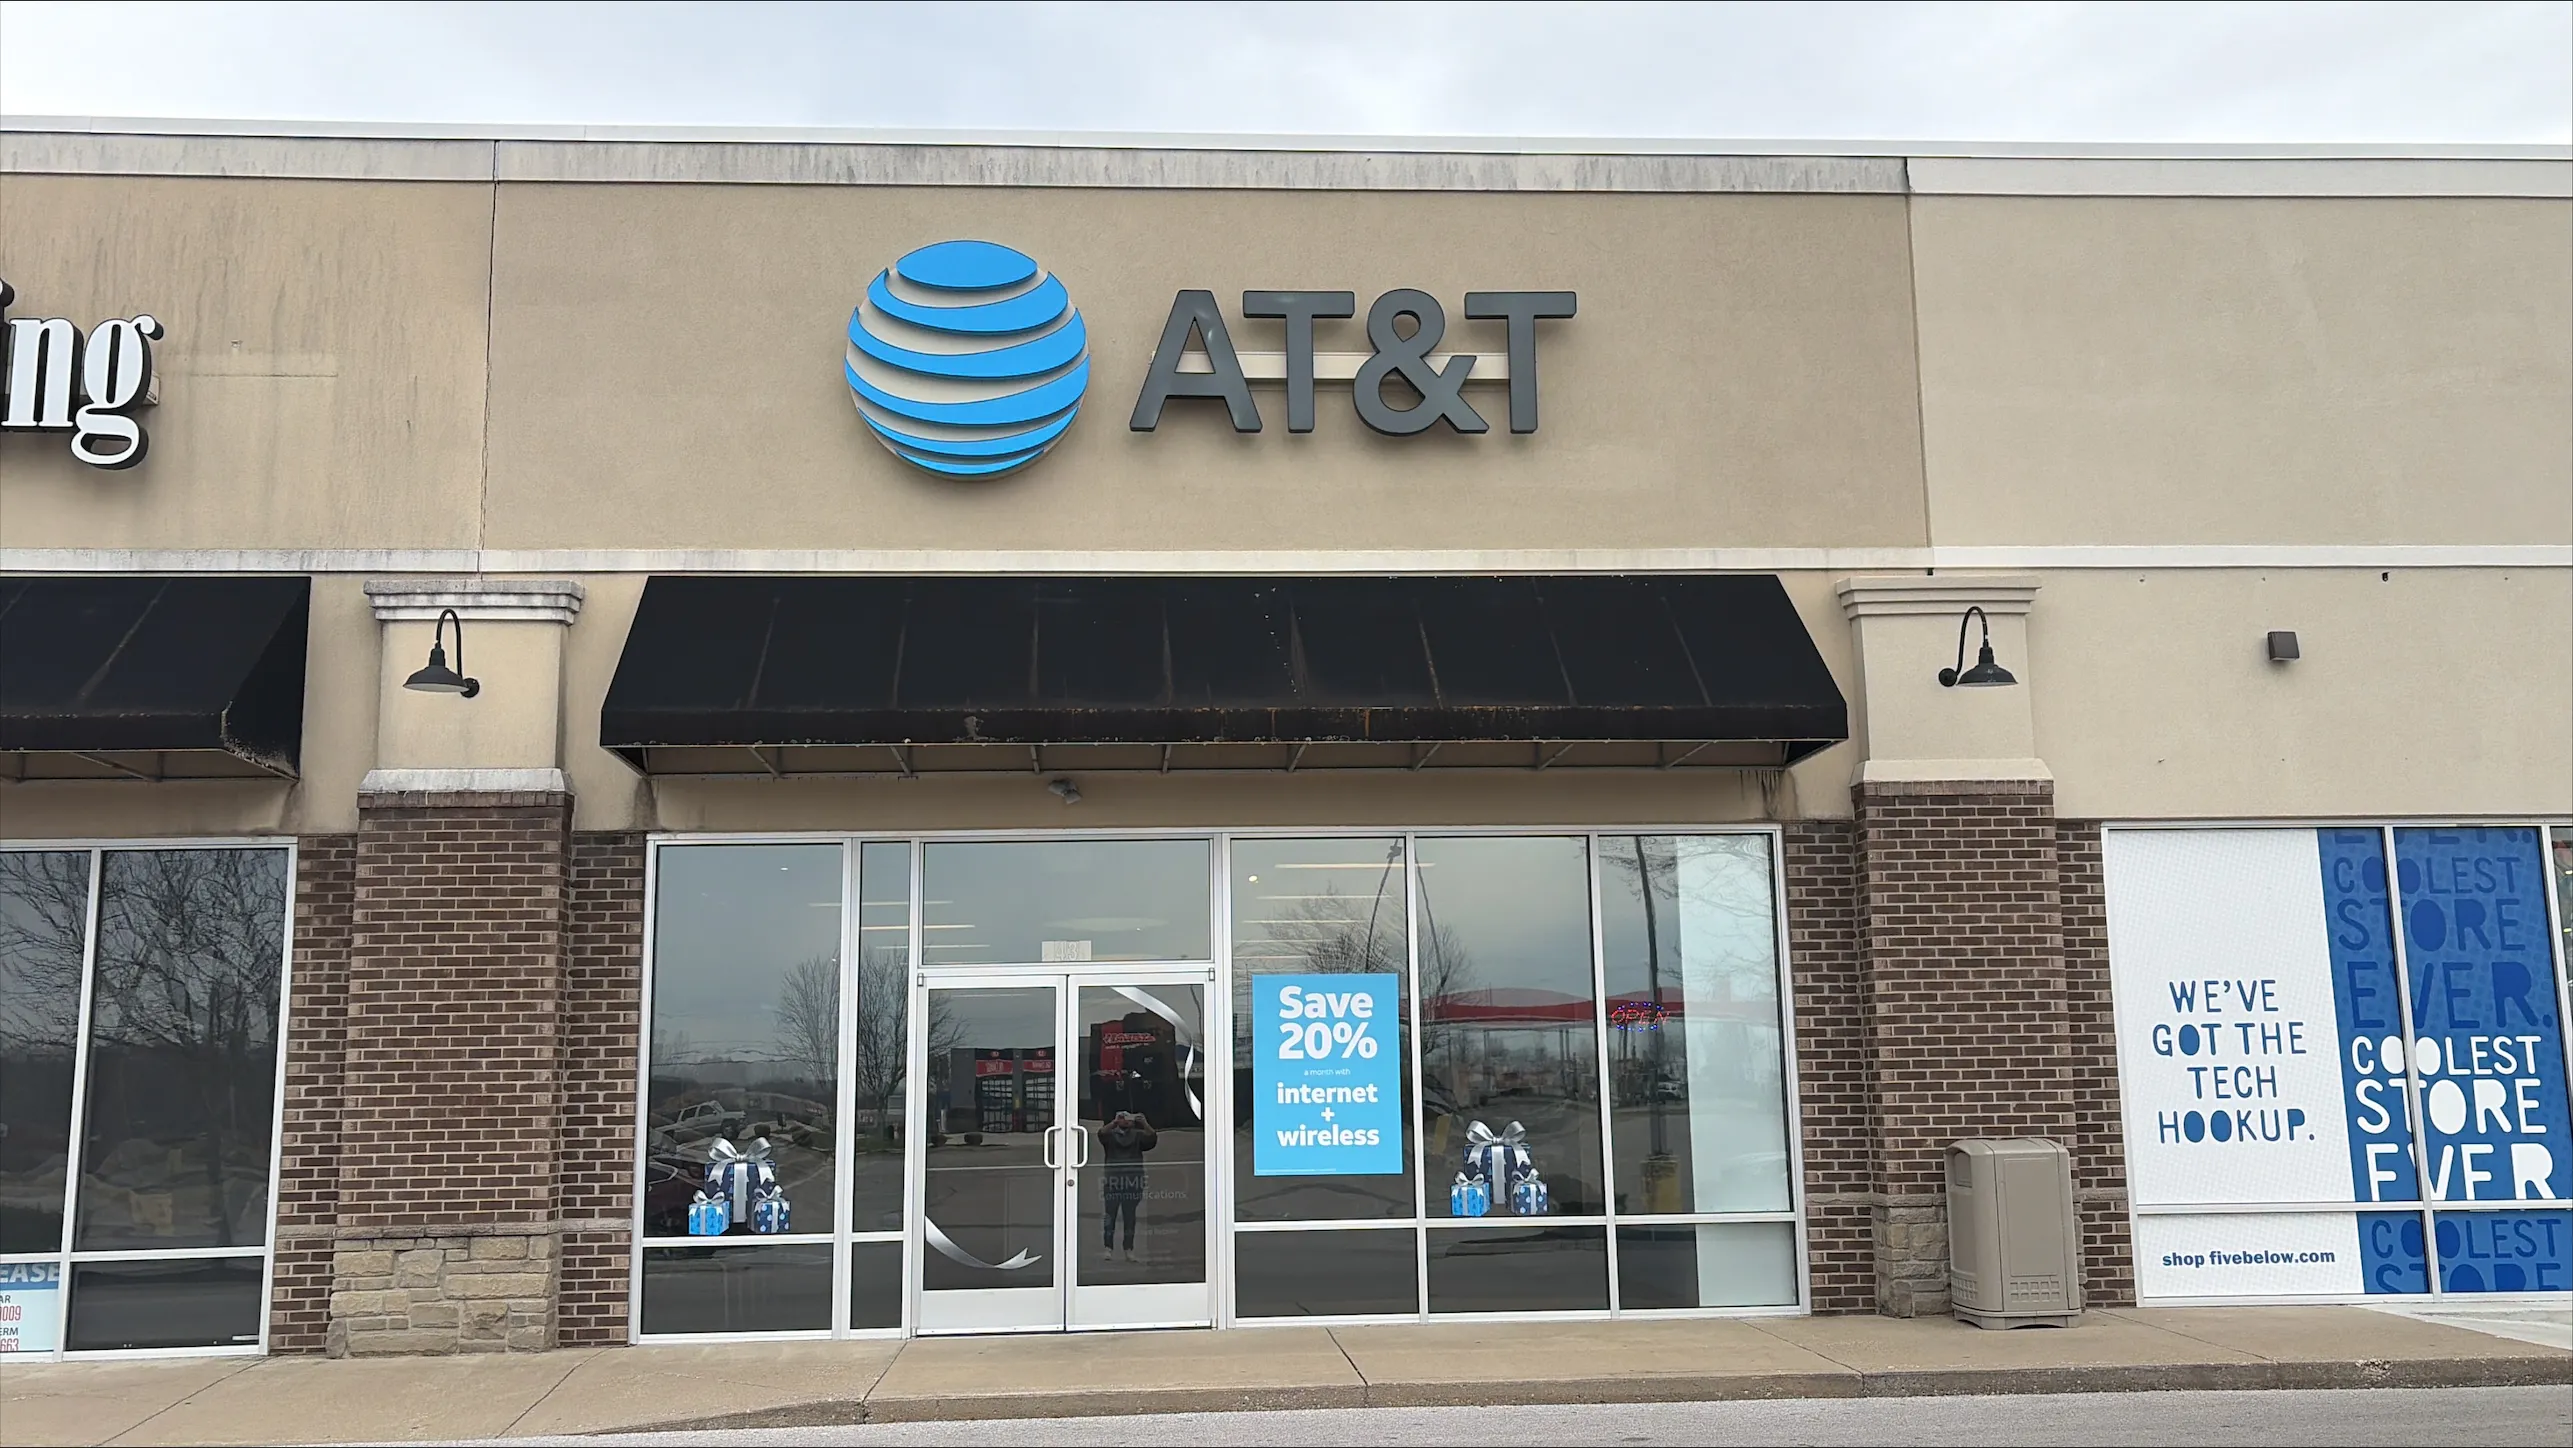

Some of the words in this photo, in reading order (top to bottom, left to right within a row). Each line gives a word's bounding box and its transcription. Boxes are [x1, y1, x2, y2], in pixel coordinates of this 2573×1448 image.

[1129, 288, 1577, 437] AT&T
[2333, 856, 2521, 895] COOLEST
[2337, 898, 2526, 952] STORE
[1279, 985, 1374, 1019] Save
[2169, 979, 2279, 1013] WE'VE
[2347, 961, 2554, 1029] EVER.
[1611, 1009, 1671, 1025] OPEN
[1279, 1022, 1378, 1060] 20%
[2152, 1023, 2222, 1057] GOT
[2234, 1021, 2307, 1055] THE
[2352, 1035, 2542, 1075] COOLEST
[1310, 1068, 1334, 1076] month
[1334, 1068, 1351, 1076] with
[2187, 1065, 2278, 1099] TECH
[1277, 1082, 1379, 1104] internet
[2355, 1078, 2547, 1135] STORE
[1277, 1124, 1380, 1147] wireless
[2158, 1108, 2316, 1144] HOOKUP.
[1098, 1175, 1150, 1191] PRIME
[2371, 1218, 2562, 1259] COOLEST
[2162, 1252, 2205, 1269] shop
[2209, 1250, 2336, 1266] fivebelow.com
[0, 1306, 22, 1321] 009
